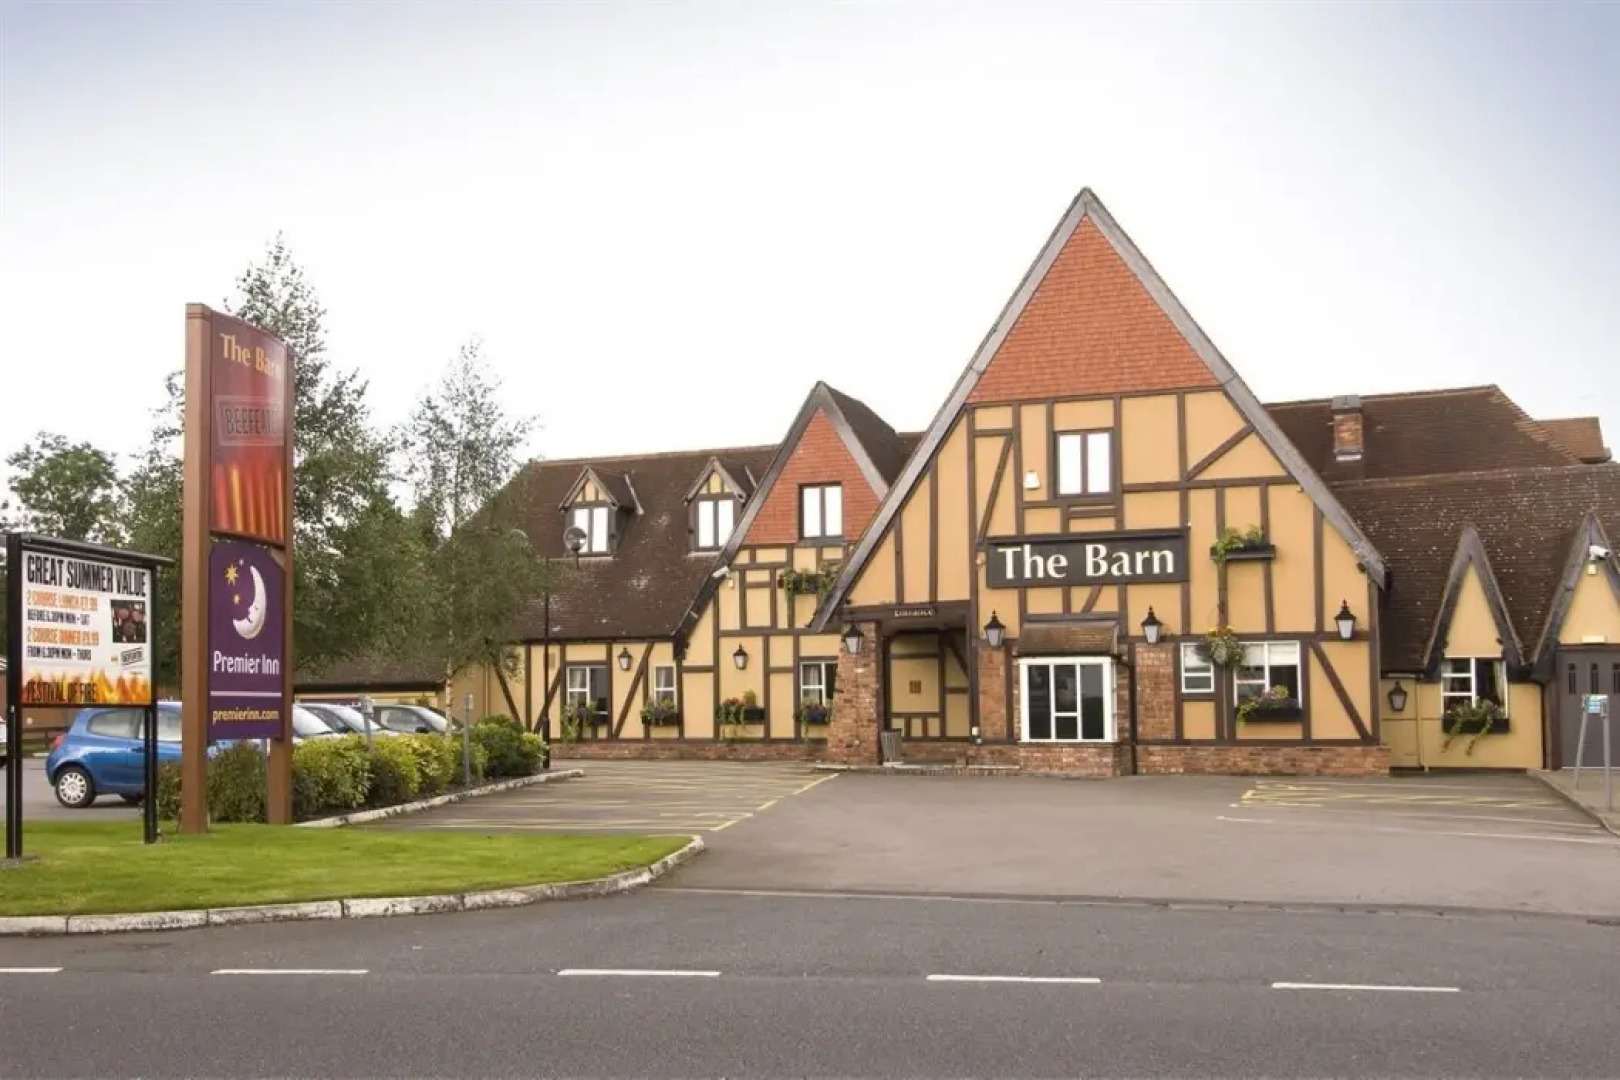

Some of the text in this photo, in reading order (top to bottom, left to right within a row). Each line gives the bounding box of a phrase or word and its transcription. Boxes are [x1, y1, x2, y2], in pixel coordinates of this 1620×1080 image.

[219, 333, 250, 366] The
[27, 555, 146, 597] GREAT SUMMER VALUE
[997, 543, 1175, 580] The Barn
[213, 650, 280, 675] Premier Inn
[27, 681, 97, 703] FESTIVAL OF FIRE
[212, 707, 279, 725] premierinn.com
